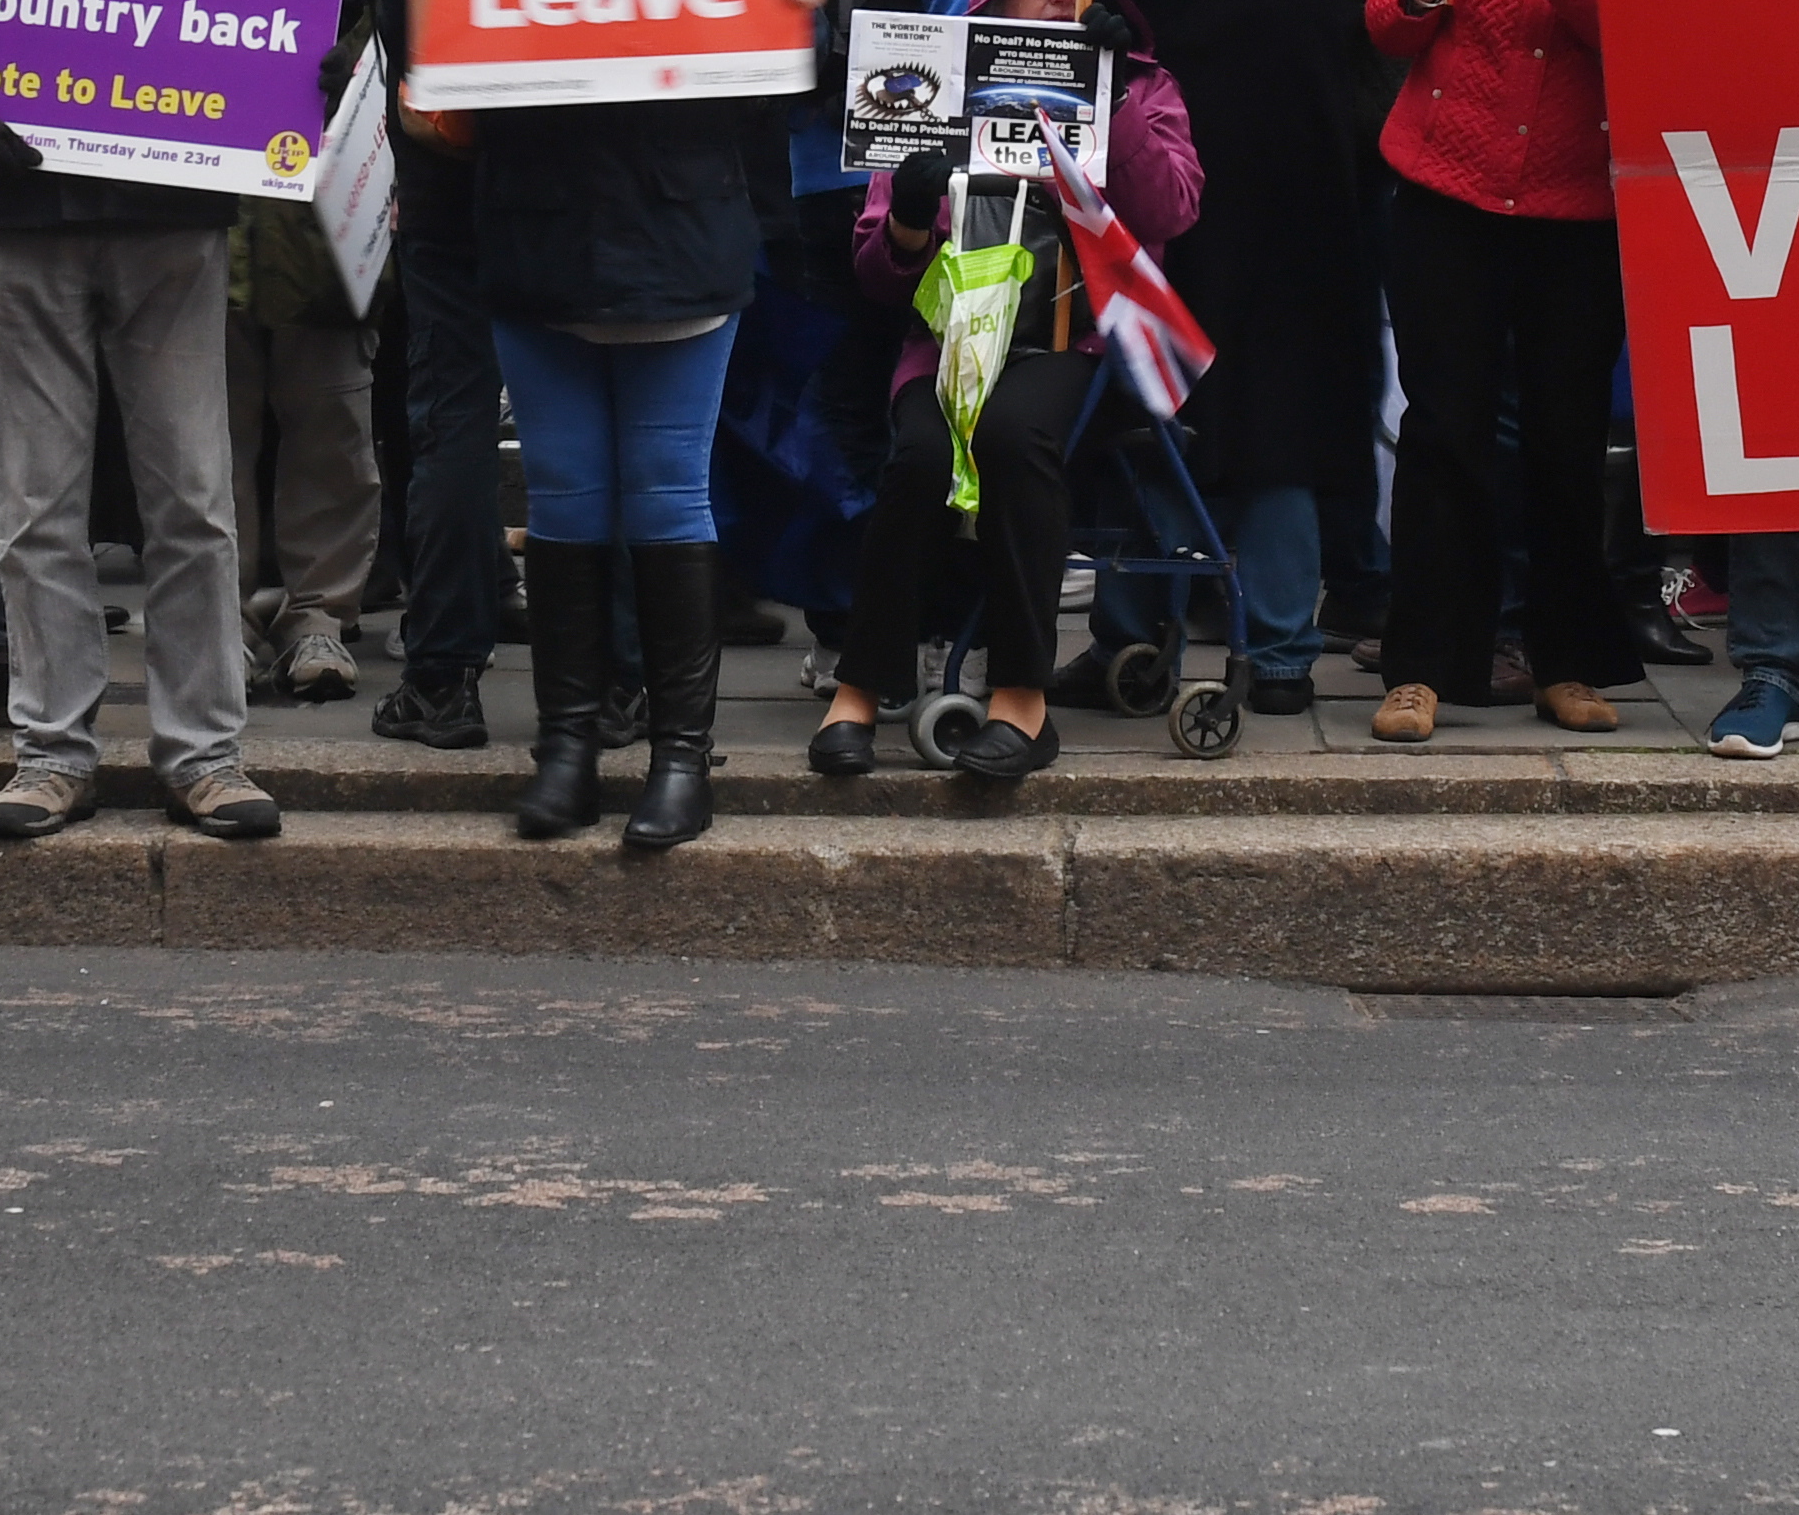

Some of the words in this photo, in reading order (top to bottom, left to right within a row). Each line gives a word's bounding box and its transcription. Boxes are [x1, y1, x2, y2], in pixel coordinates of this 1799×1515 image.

[871, 22, 887, 30] THE
[889, 23, 920, 32] WORST
[922, 25, 944, 33] DEAL
[894, 32, 931, 41] HISTORY
[974, 34, 990, 44] No
[992, 35, 1023, 46] Deal?
[1025, 37, 1042, 47] No
[994, 58, 1025, 67] BRITAIN
[998, 50, 1017, 58] WTO
[1019, 51, 1043, 60] RULES
[1045, 53, 1068, 61] MEAN
[56, 68, 97, 105] to
[110, 75, 227, 120] Leave
[850, 120, 866, 130] No
[868, 121, 899, 132] Deal?
[901, 123, 917, 133] No
[919, 125, 969, 136] Problem!
[991, 122, 1081, 145] LEAE
[67, 138, 135, 159] Thursday
[141, 147, 178, 162] June
[184, 151, 220, 167] 23rd
[270, 147, 305, 159] UKIP
[994, 146, 1032, 165] the
[261, 177, 304, 193] ukip.org
